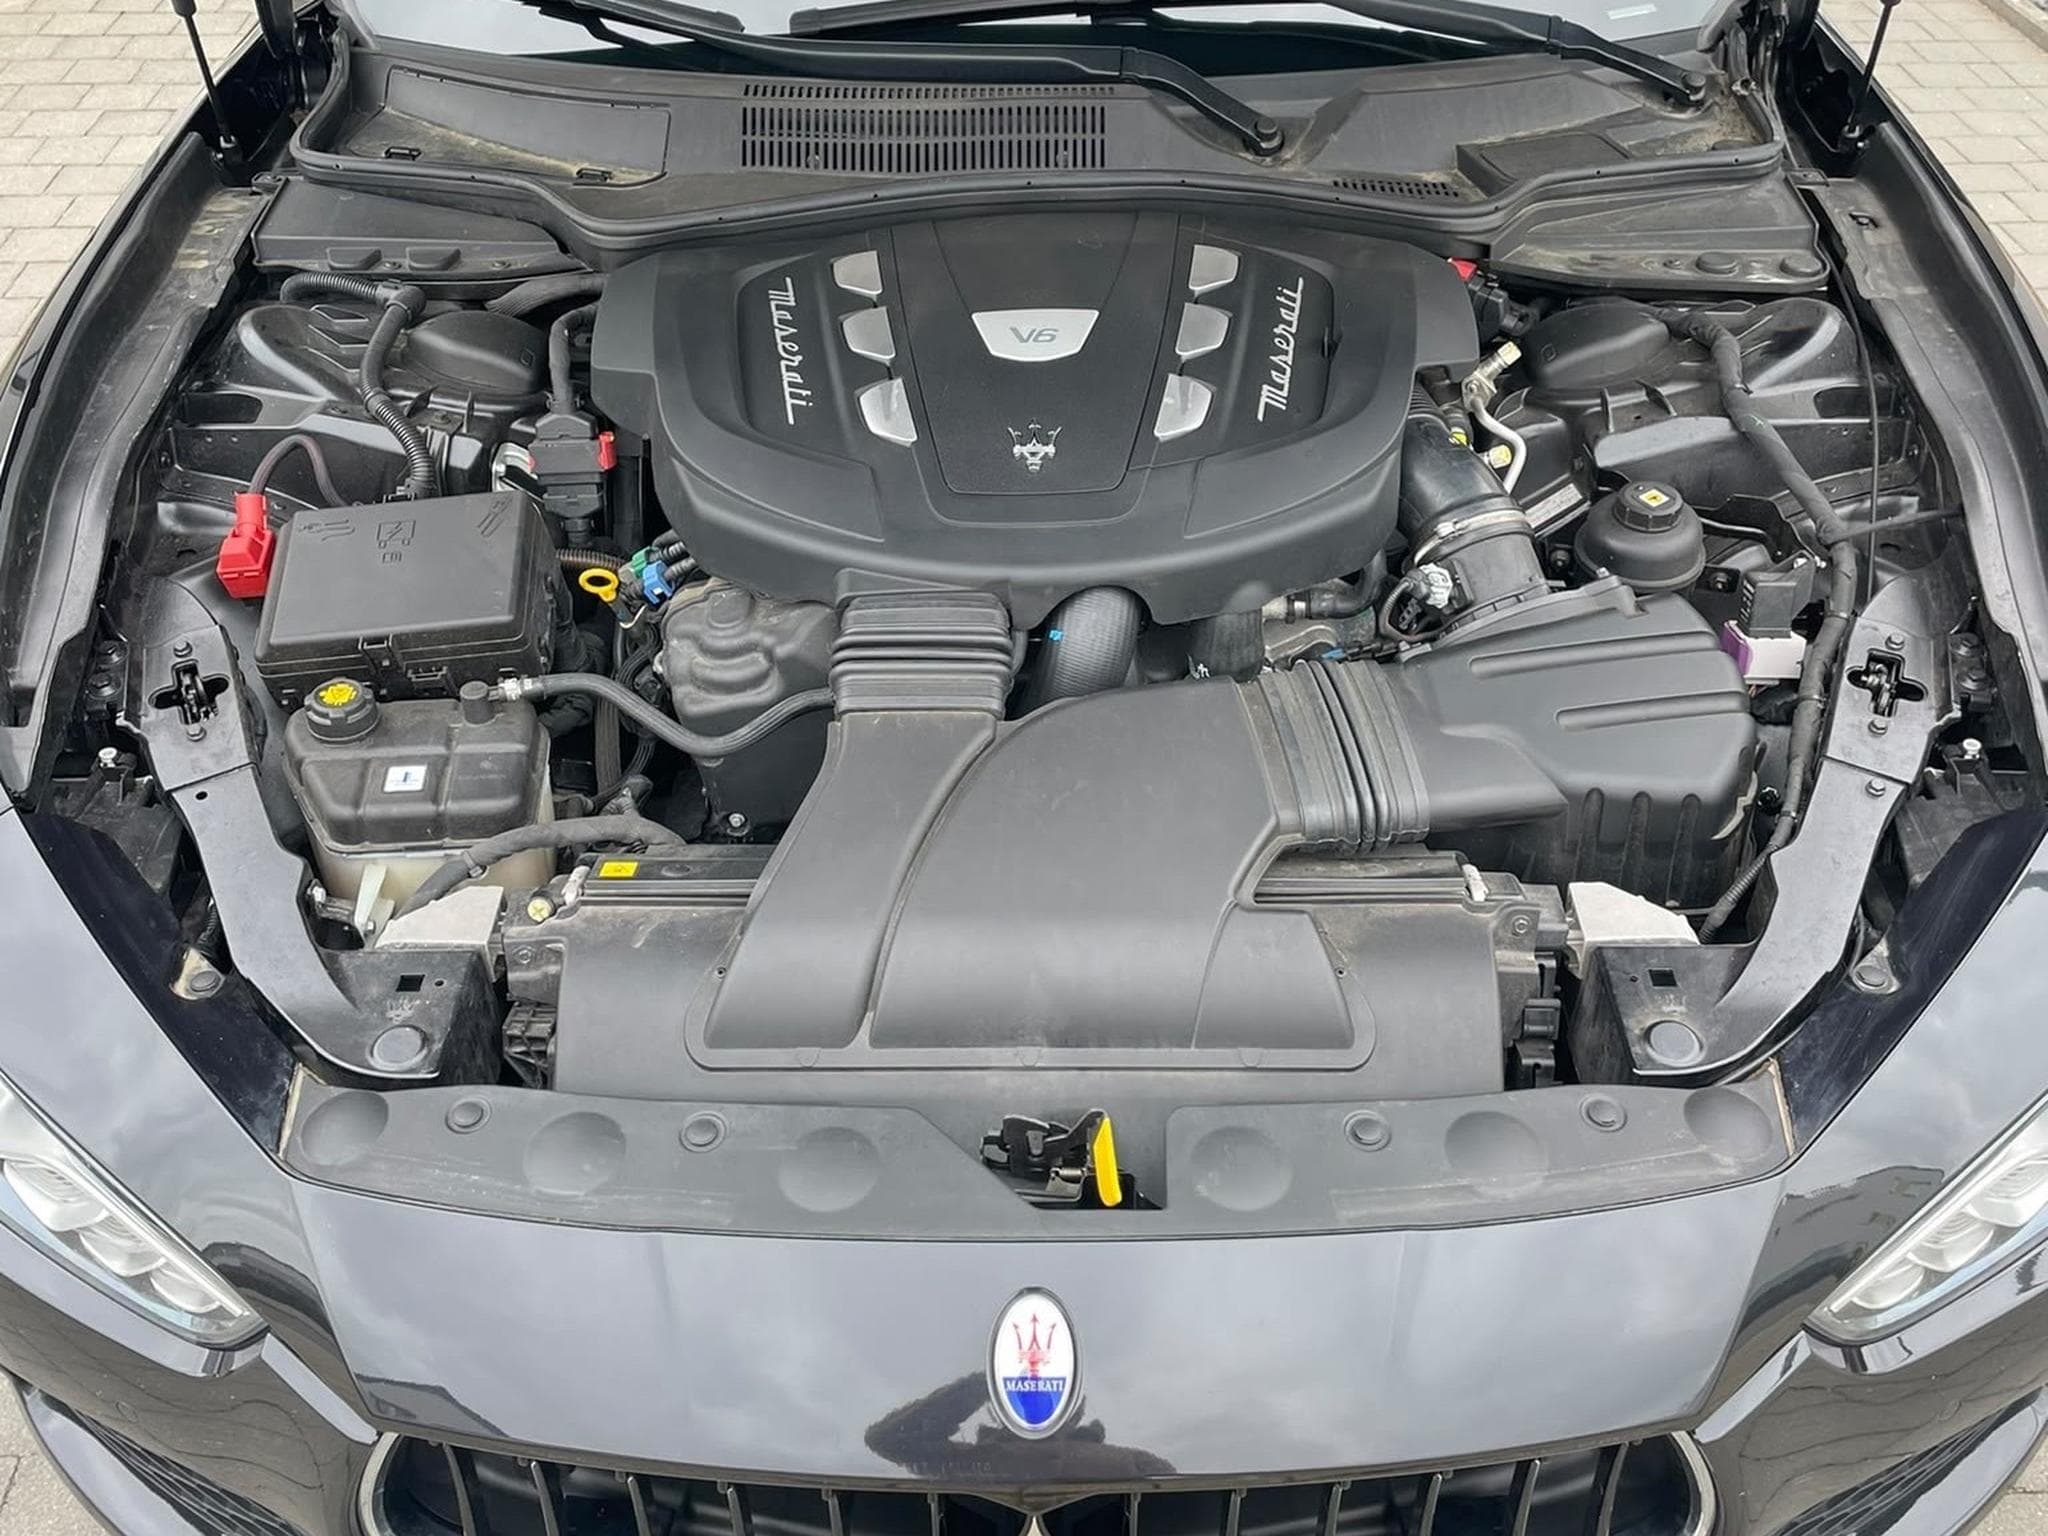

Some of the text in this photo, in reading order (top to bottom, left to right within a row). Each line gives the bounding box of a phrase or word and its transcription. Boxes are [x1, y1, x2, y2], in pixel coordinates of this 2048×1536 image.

[768, 277, 813, 424] Maserati
[1009, 327, 1059, 344] V6
[1257, 277, 1304, 421] Maserati
[1005, 1380, 1064, 1391] MASERATI
